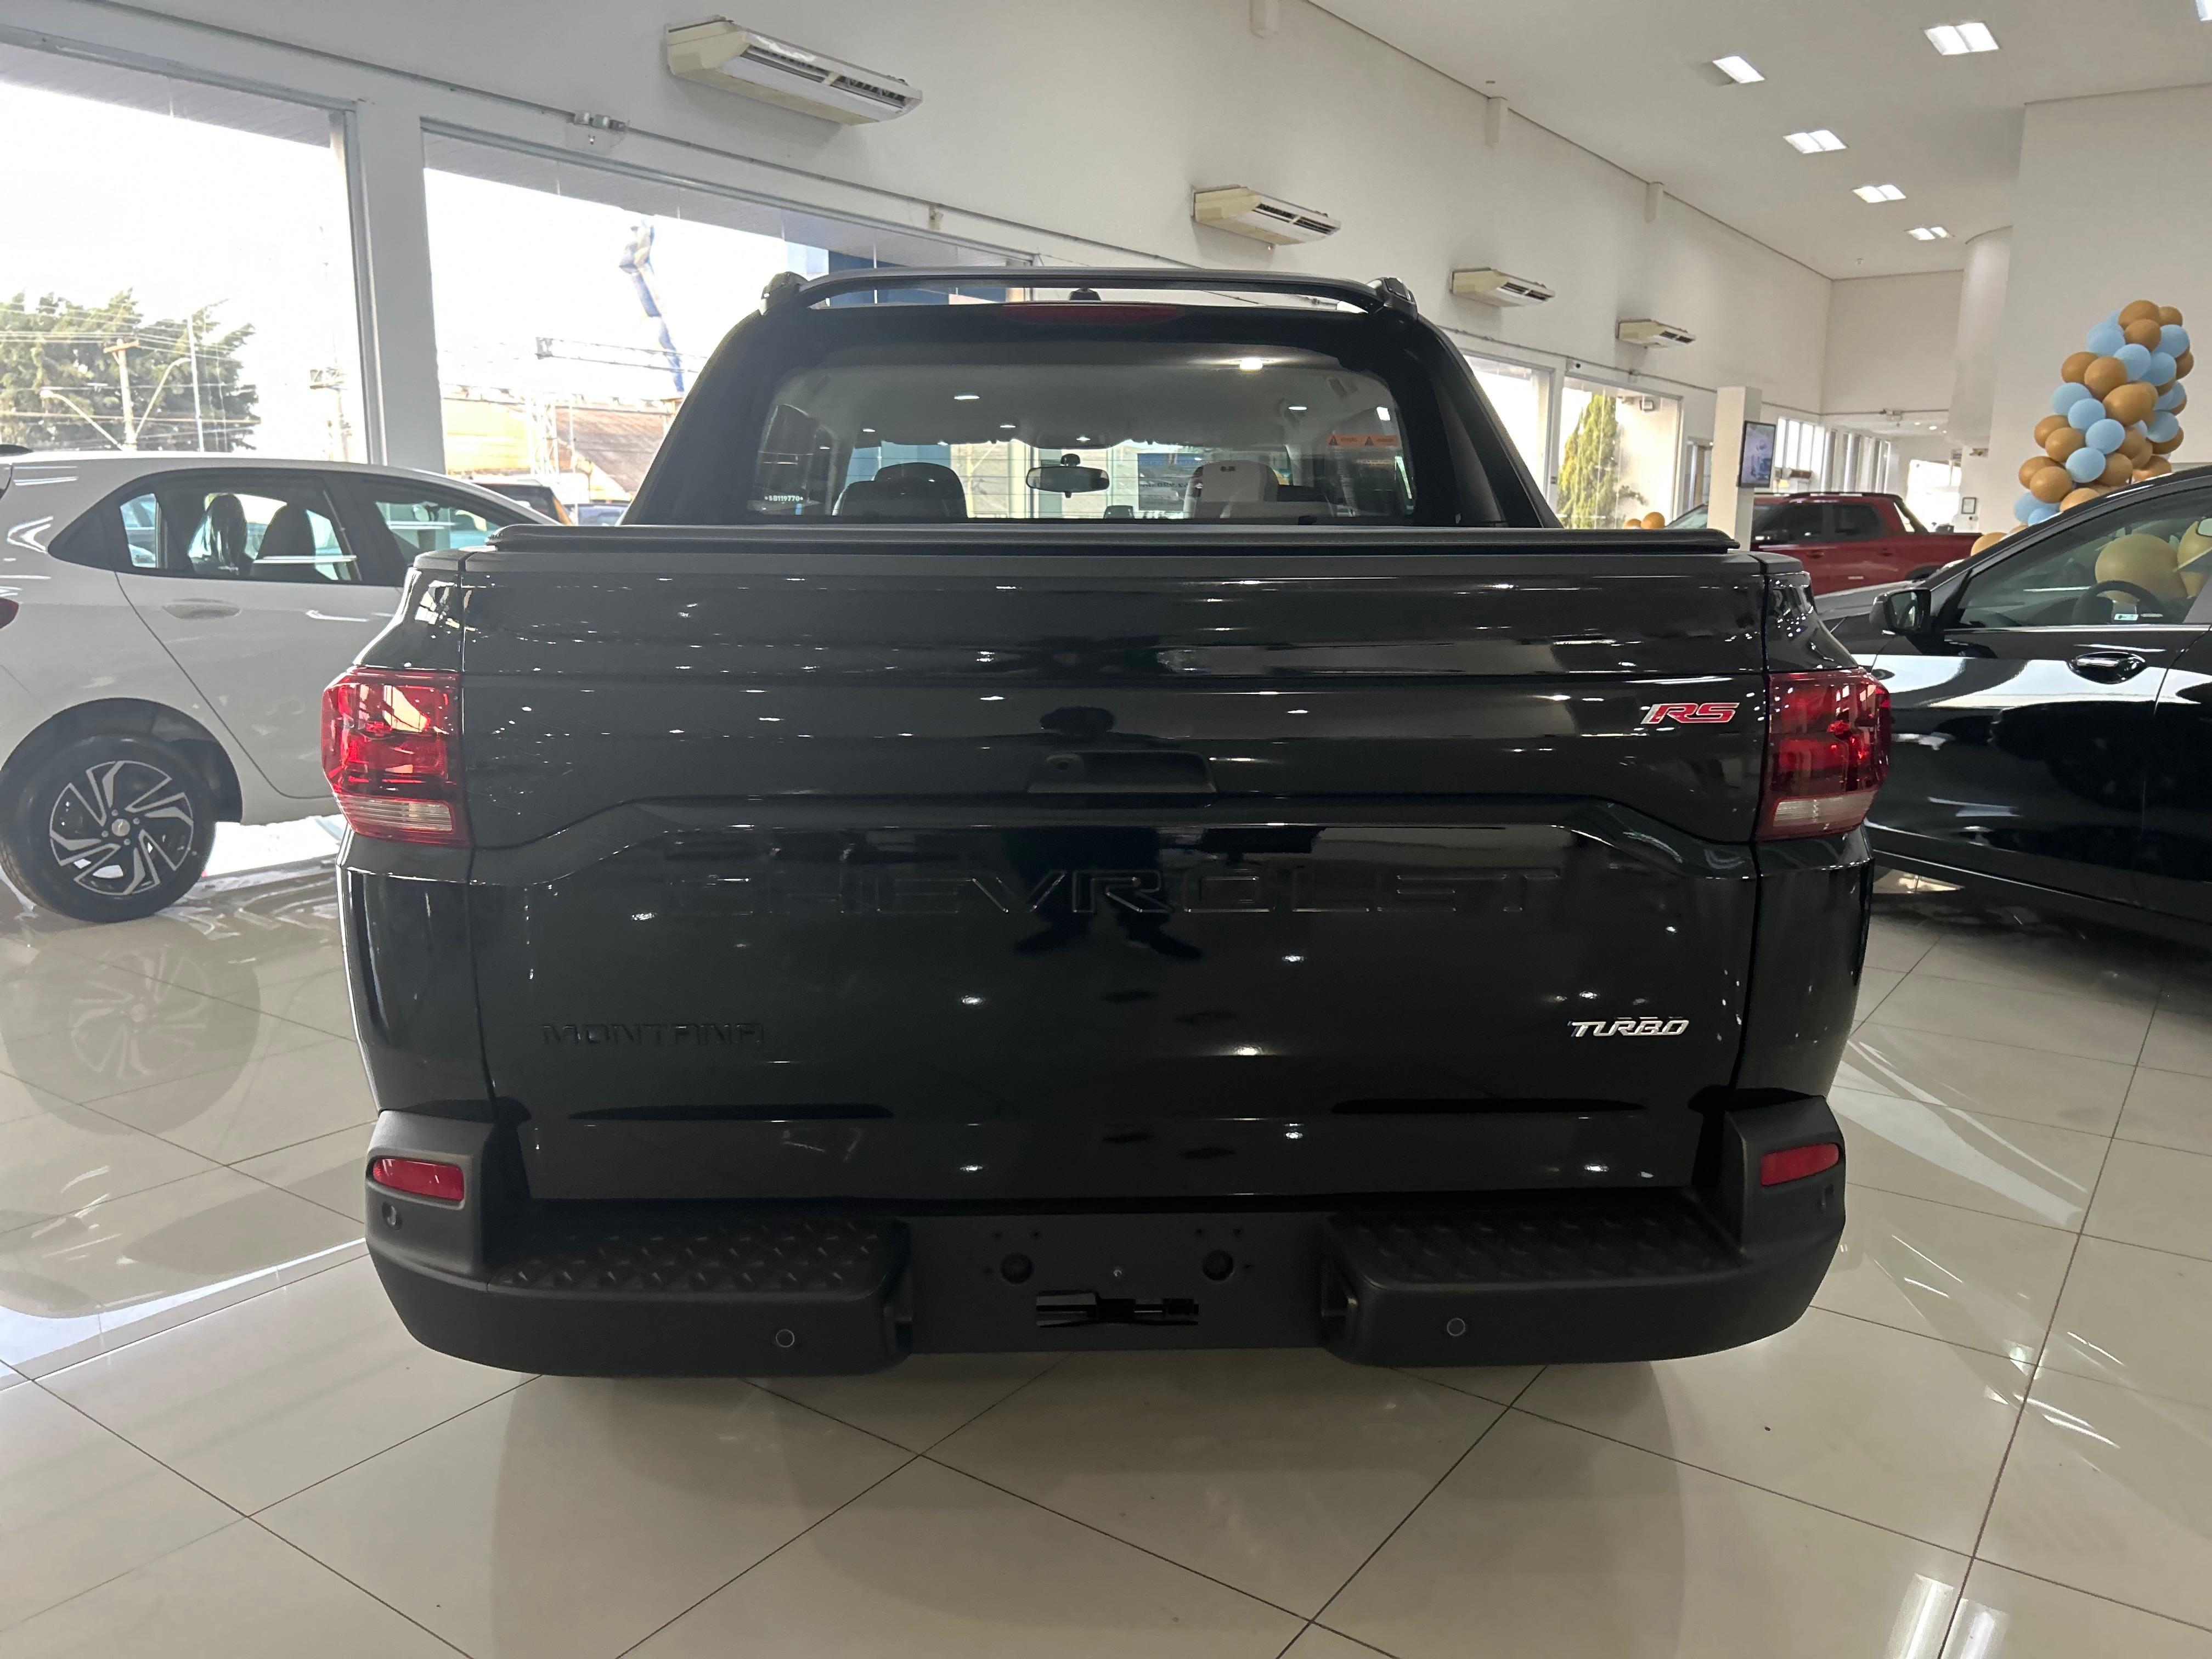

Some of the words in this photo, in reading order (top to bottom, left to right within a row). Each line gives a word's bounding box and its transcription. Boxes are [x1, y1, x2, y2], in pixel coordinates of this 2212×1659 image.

[1640, 702, 1740, 724] RS
[669, 867, 1561, 915] CHEVROLET
[541, 1023, 765, 1045] MONTANA
[1568, 1020, 1689, 1037] TURBO
